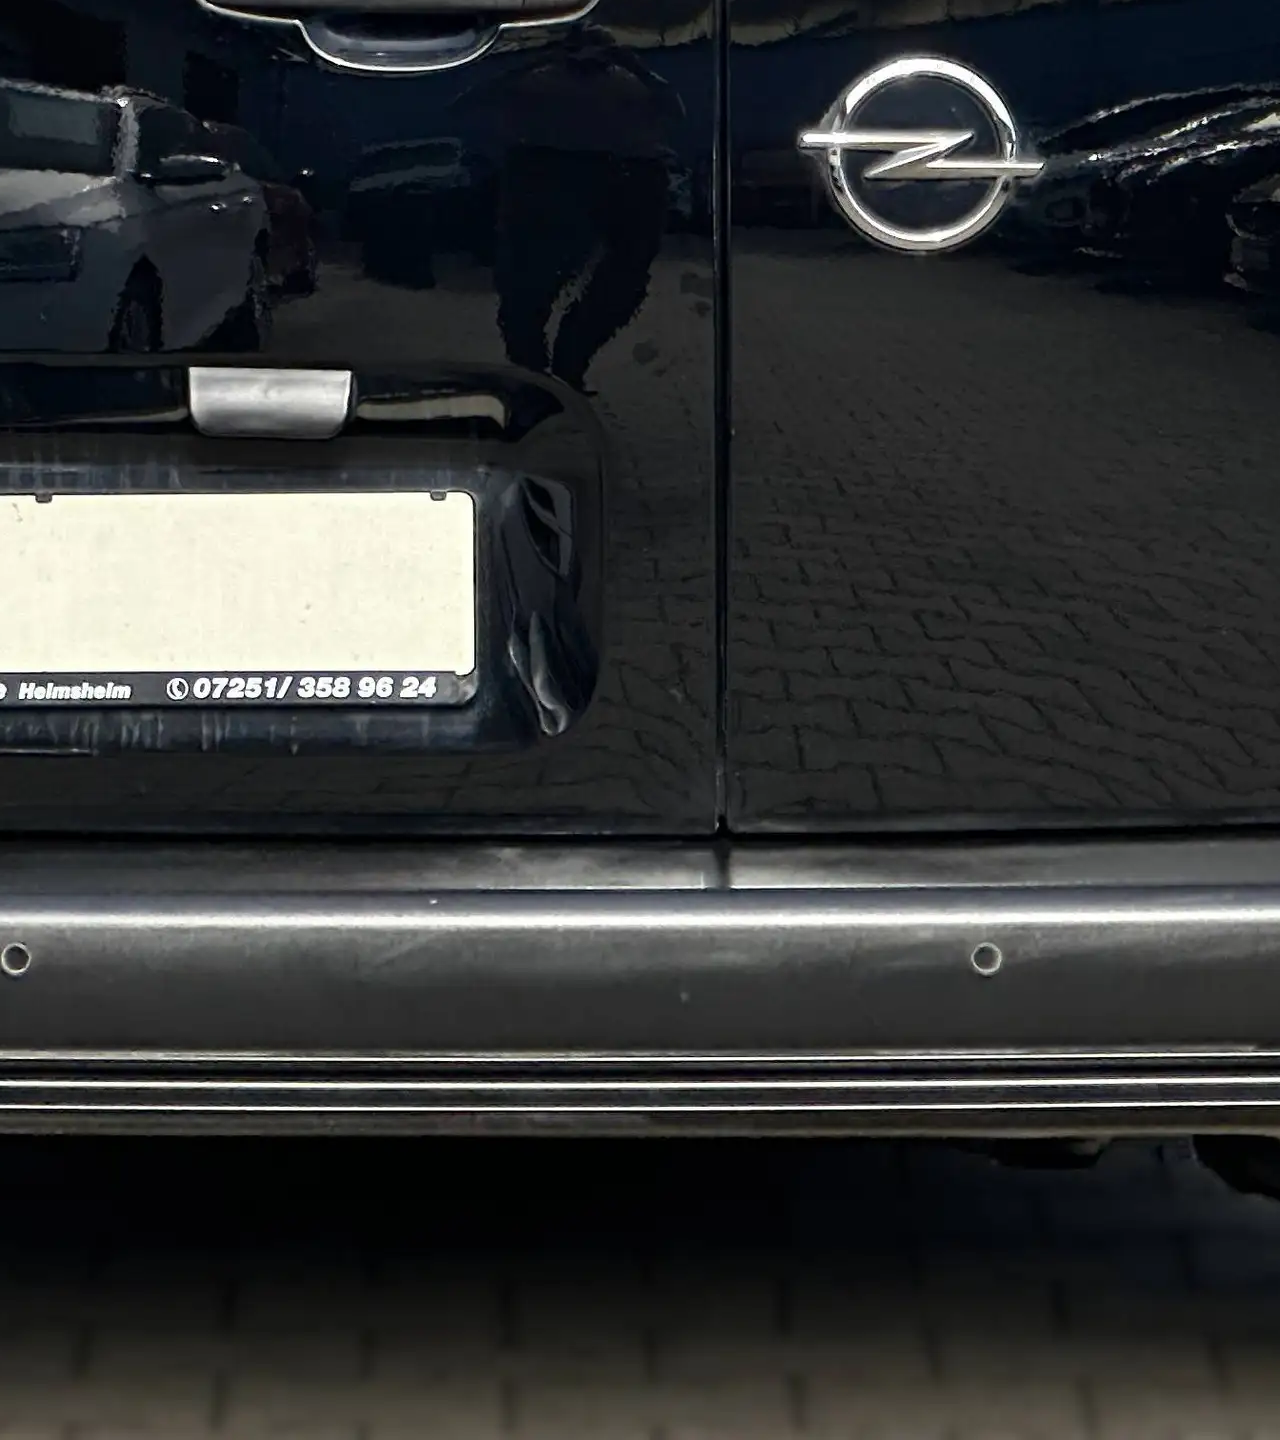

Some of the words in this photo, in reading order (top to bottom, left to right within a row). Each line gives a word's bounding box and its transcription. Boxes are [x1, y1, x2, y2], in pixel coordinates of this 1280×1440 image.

[18, 681, 132, 700] Helmsheim
[193, 676, 290, 699] 07251/
[297, 676, 351, 698] 358
[357, 676, 394, 698] 96
[399, 676, 437, 698] 24
